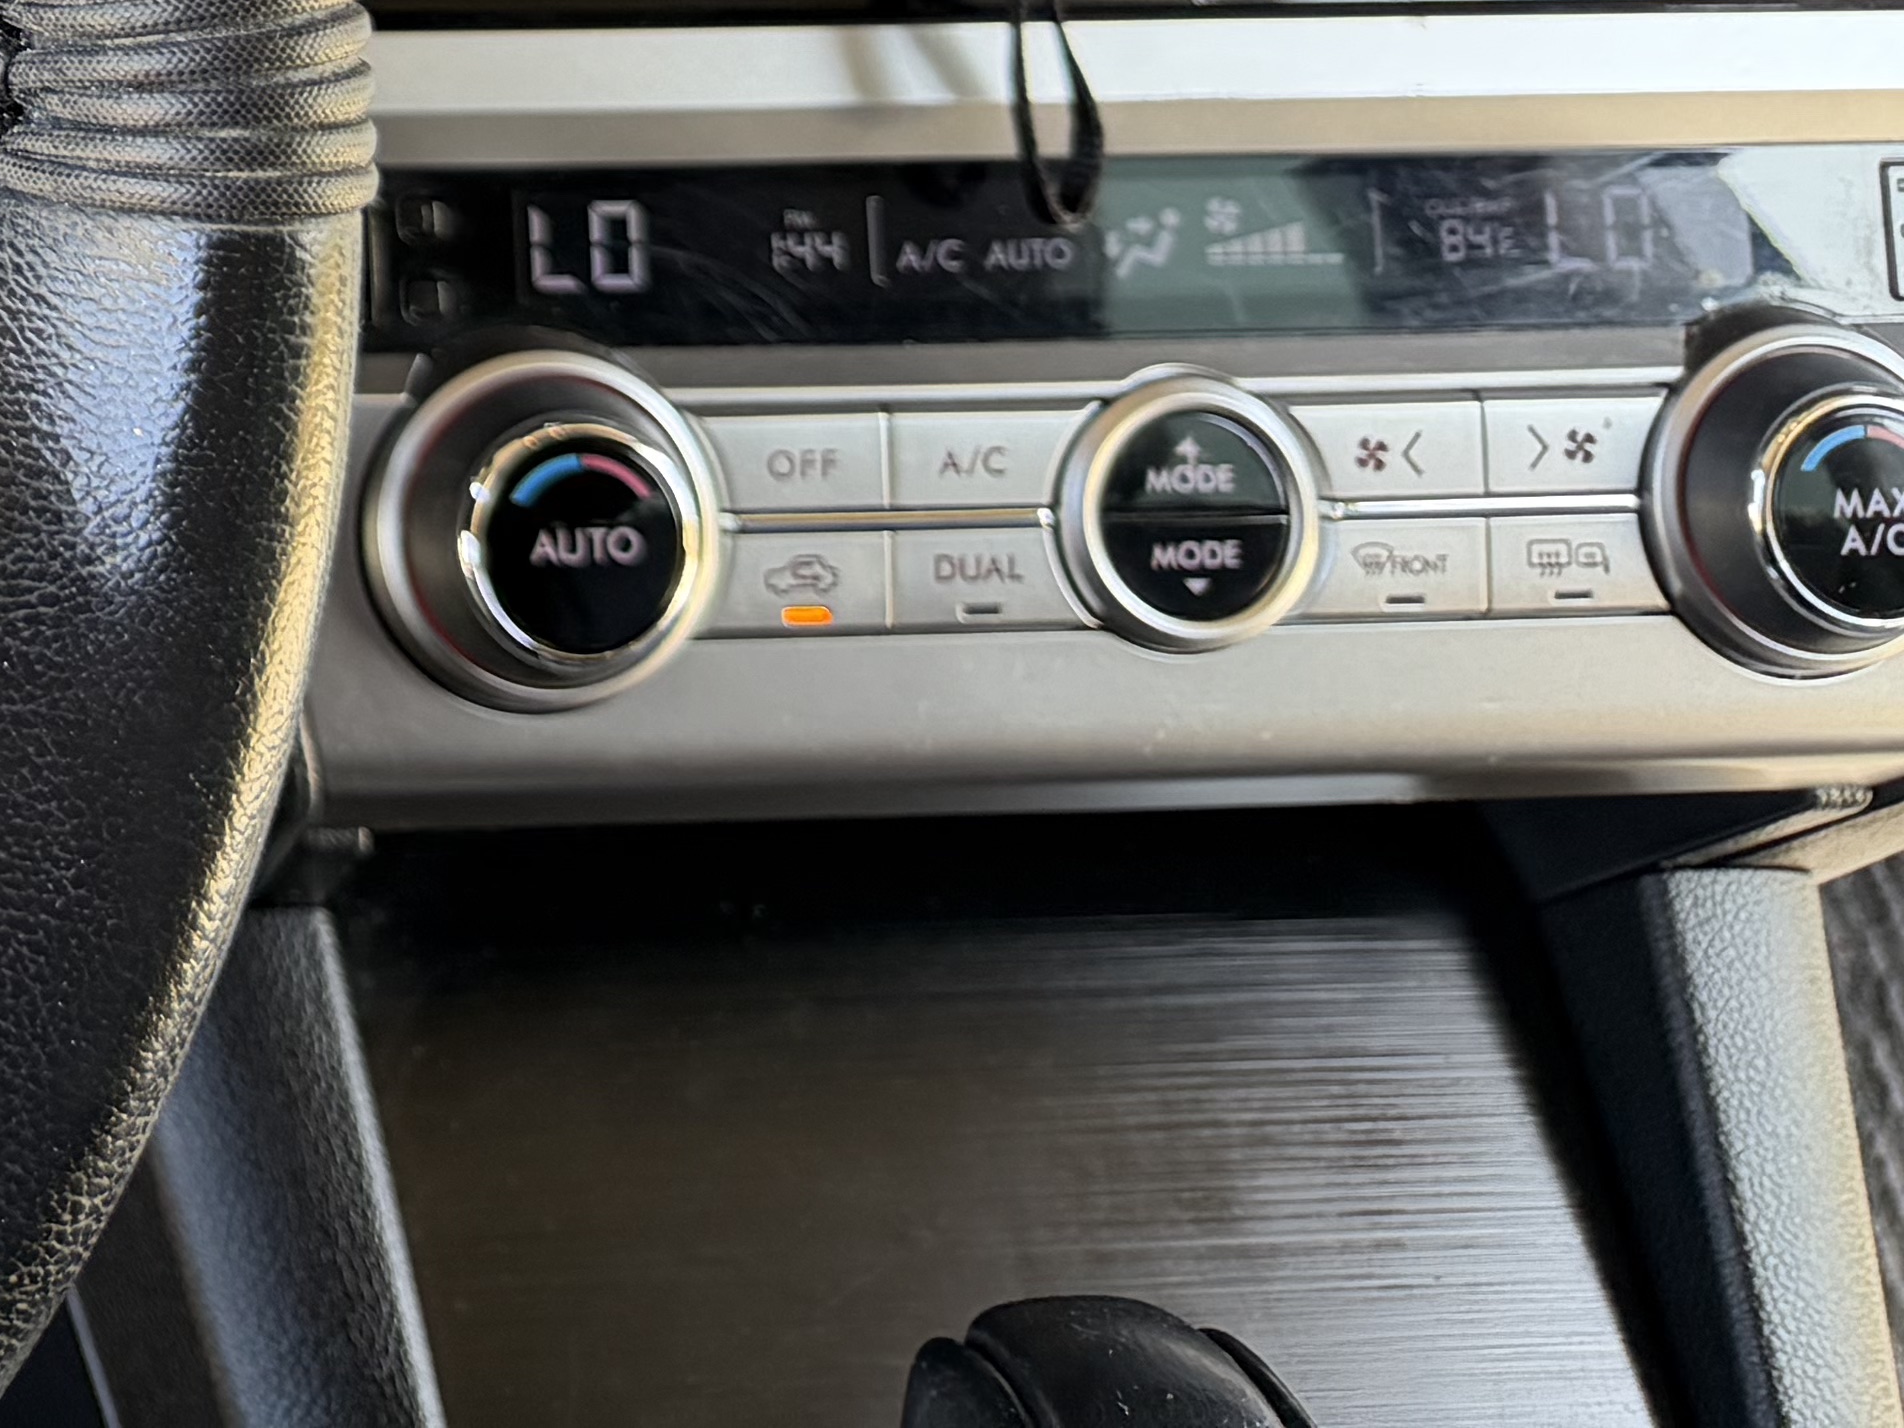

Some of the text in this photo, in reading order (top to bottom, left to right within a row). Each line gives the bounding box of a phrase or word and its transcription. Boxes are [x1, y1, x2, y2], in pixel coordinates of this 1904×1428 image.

[896, 236, 1072, 273] A/C AUTO
[767, 449, 839, 481] OFF
[941, 445, 1009, 477] A/C
[1146, 463, 1237, 494] MODE
[530, 528, 645, 566] AUTO
[1151, 539, 1243, 571] MODE
[934, 553, 1026, 584] DUAL
[1391, 553, 1449, 578] FRONT
